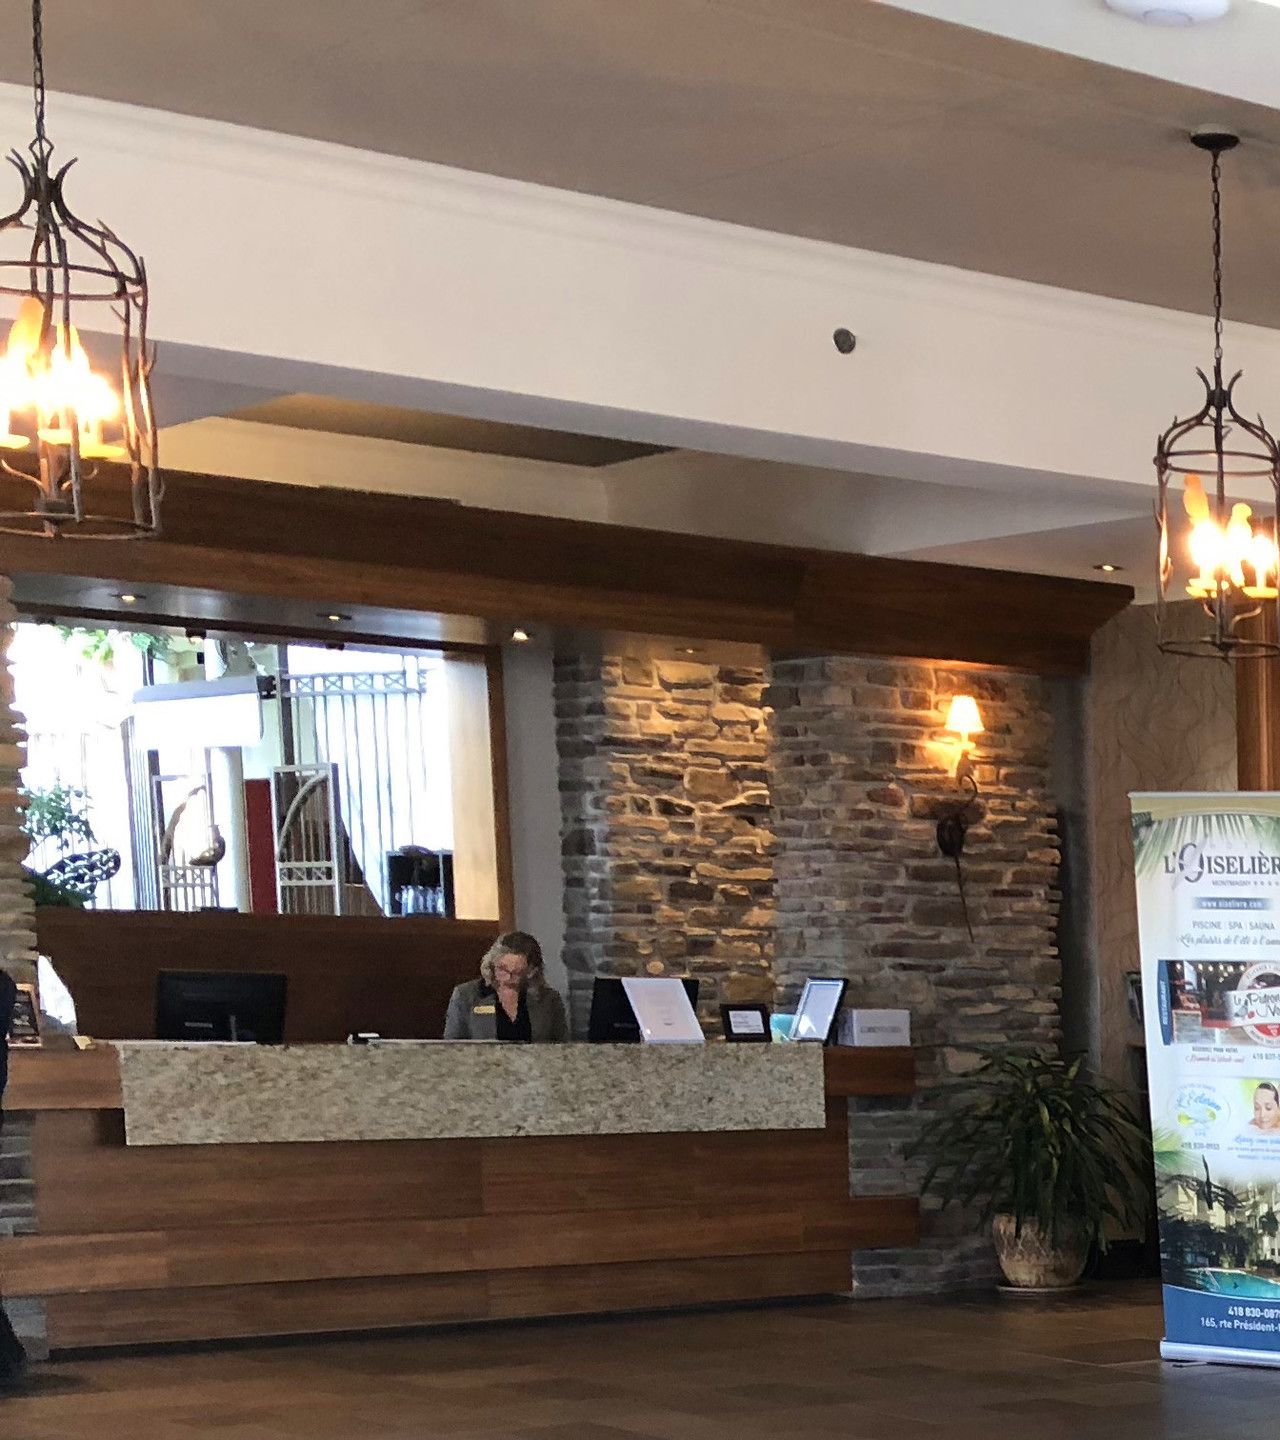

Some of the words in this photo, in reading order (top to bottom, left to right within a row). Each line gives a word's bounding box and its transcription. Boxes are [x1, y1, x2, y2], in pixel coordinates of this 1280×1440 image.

[1192, 920, 1222, 930] PISCINE
[1228, 921, 1243, 930] SPA
[1249, 921, 1276, 931] SAUNA
[1227, 1305, 1244, 1317] 418
[1200, 1317, 1218, 1329] 165,
[1220, 1319, 1233, 1329] rte
